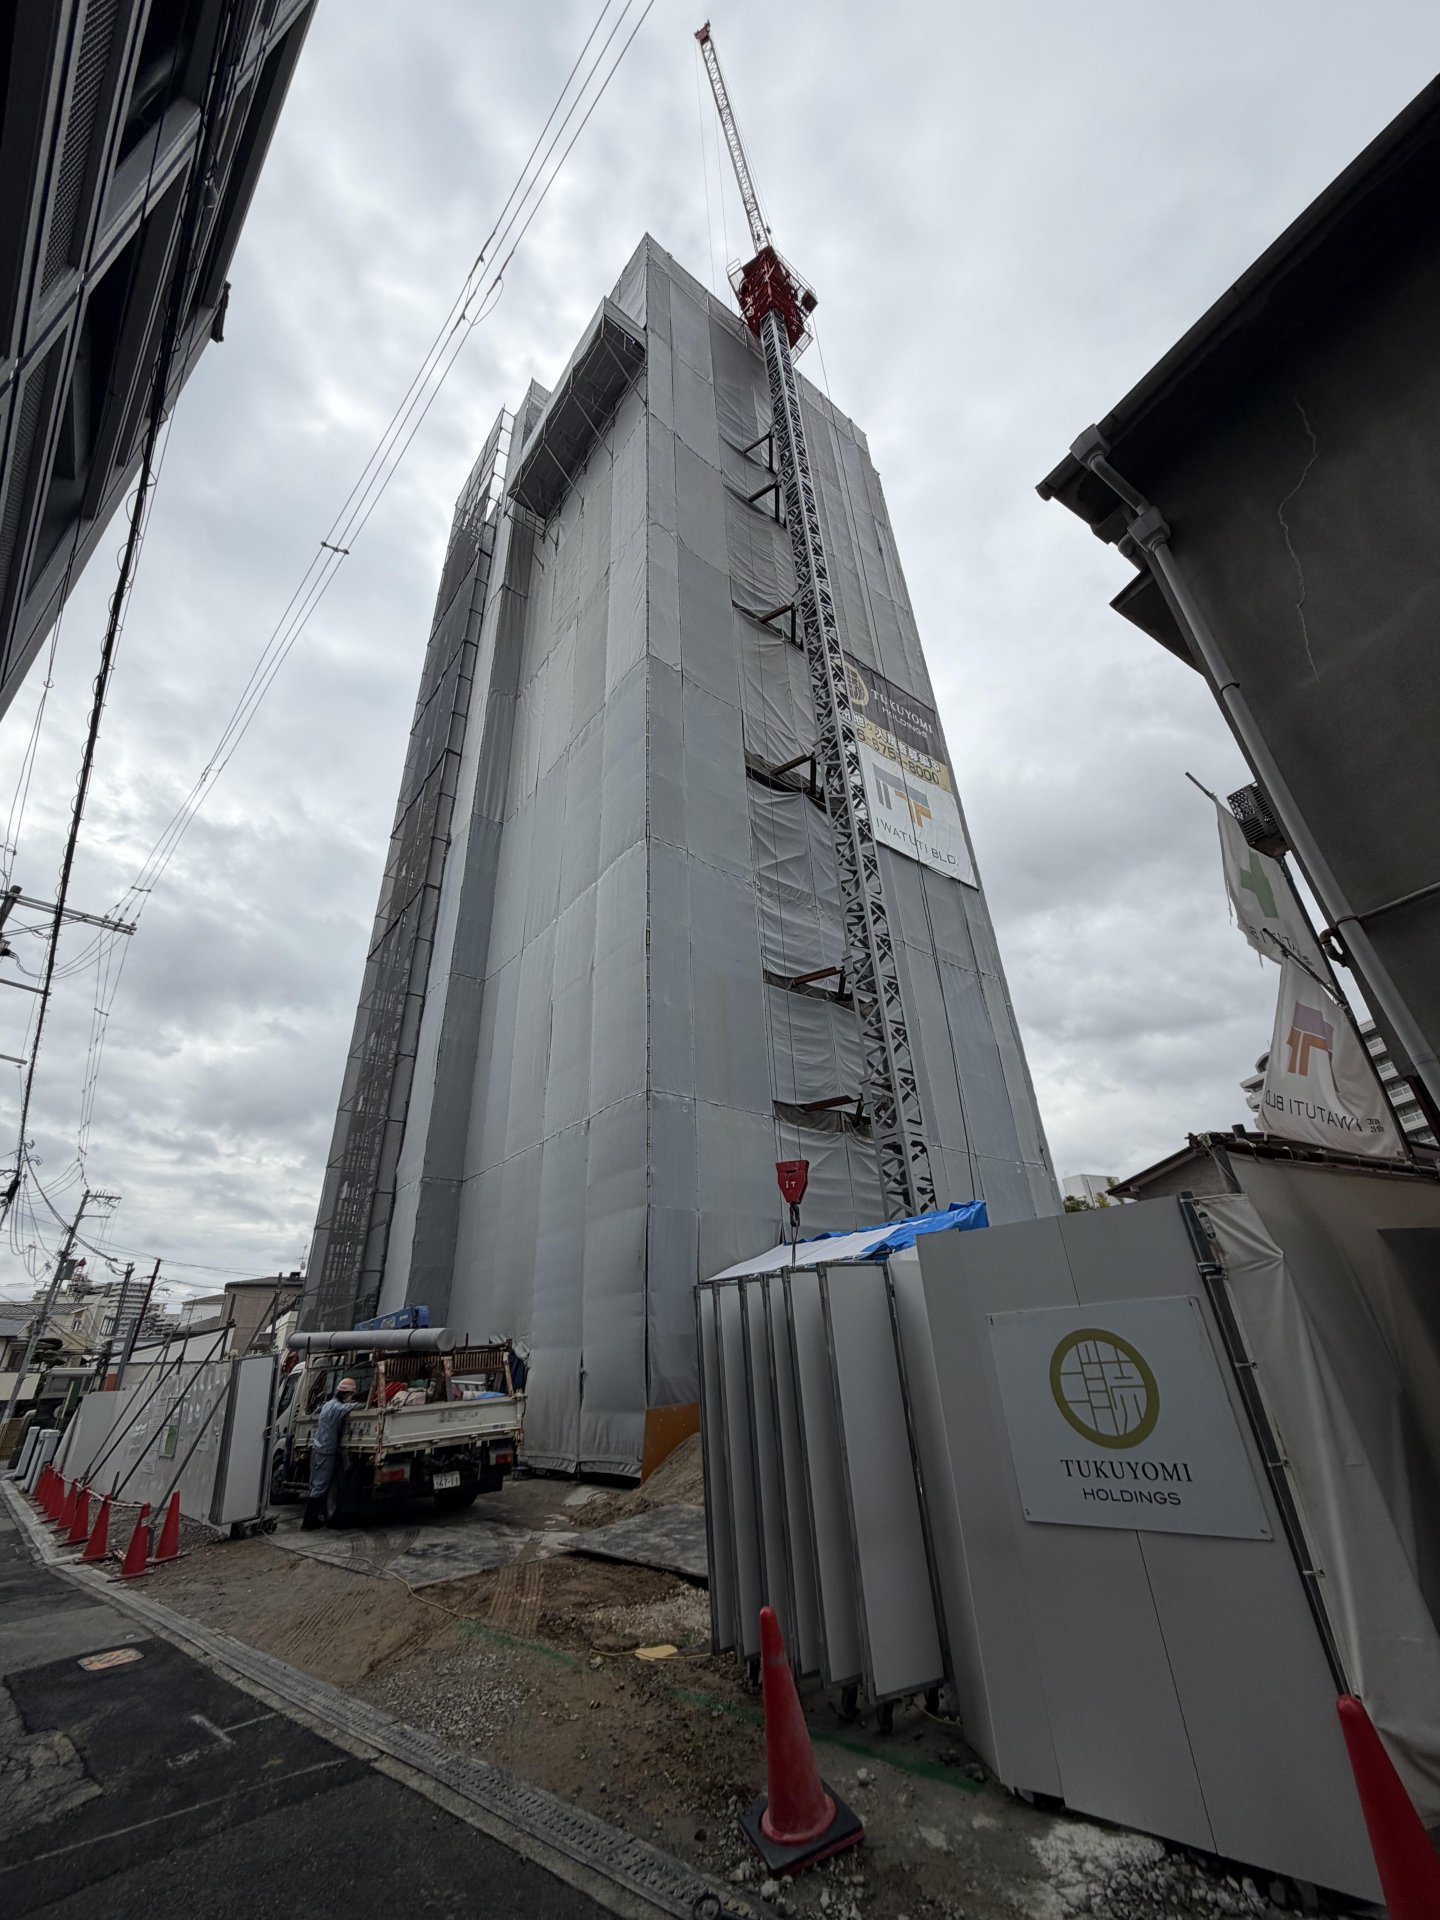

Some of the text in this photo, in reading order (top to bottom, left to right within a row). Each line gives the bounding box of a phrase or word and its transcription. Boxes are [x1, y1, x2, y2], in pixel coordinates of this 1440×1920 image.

[870, 688, 933, 734] TUKUYOMI
[876, 817, 928, 854] IWATUTI
[1060, 1459, 1193, 1482] TUKUYOMI
[1083, 1488, 1182, 1505] HOLDINGS
